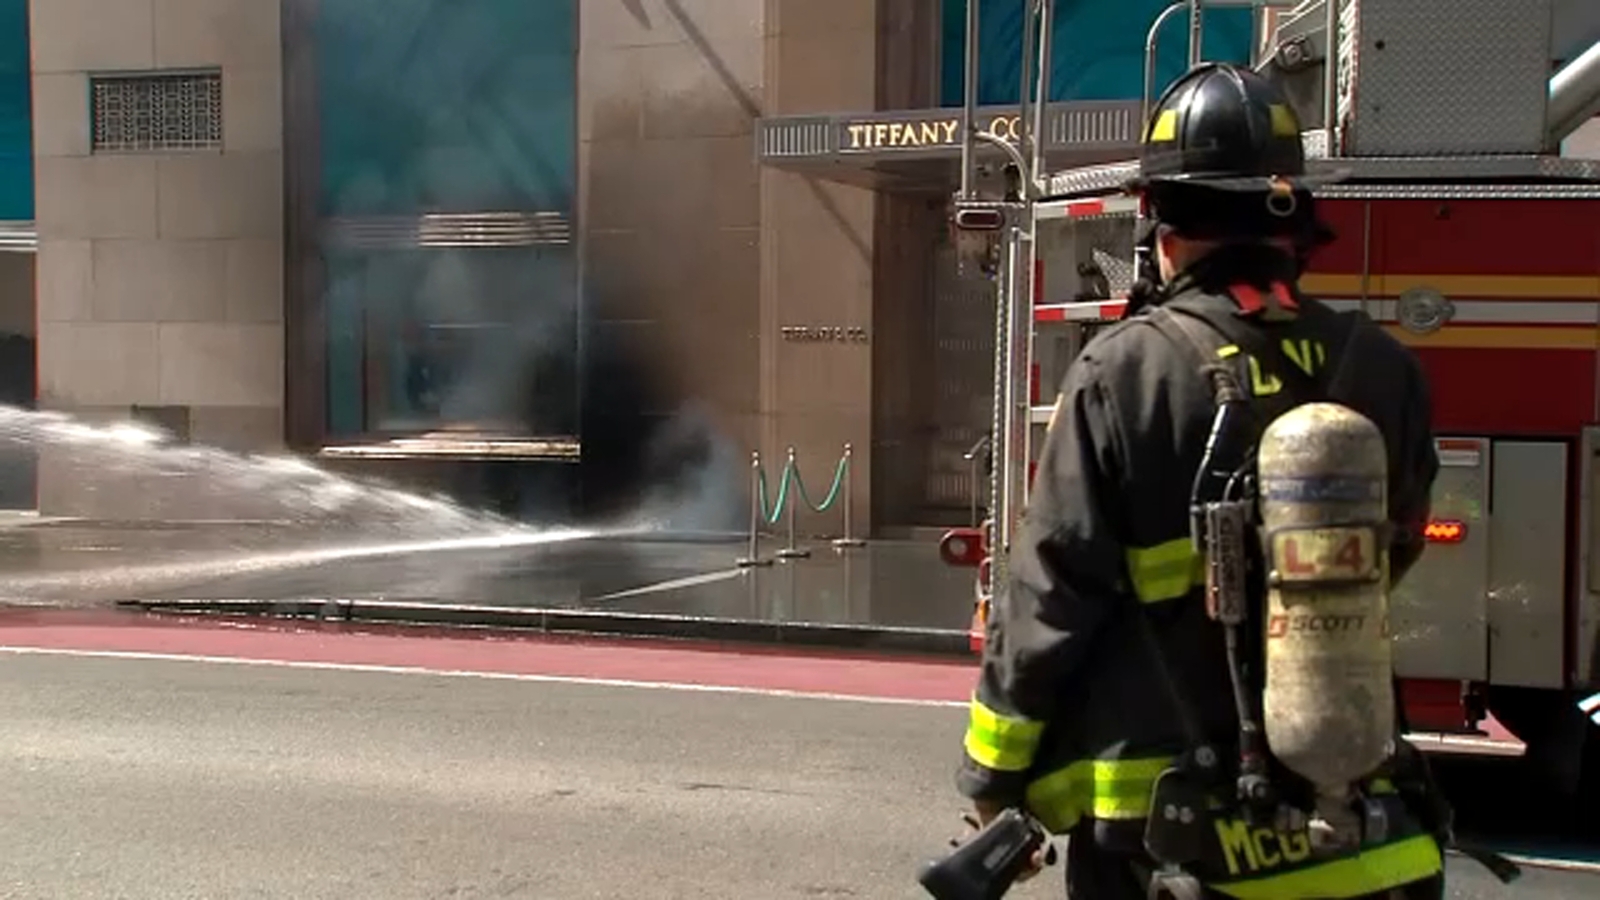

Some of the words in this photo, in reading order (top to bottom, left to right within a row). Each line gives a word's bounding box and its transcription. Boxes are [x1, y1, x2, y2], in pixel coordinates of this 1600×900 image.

[848, 119, 958, 148] TIFFANY
[1283, 534, 1364, 575] L-4
[1291, 613, 1367, 632] SCOTT
